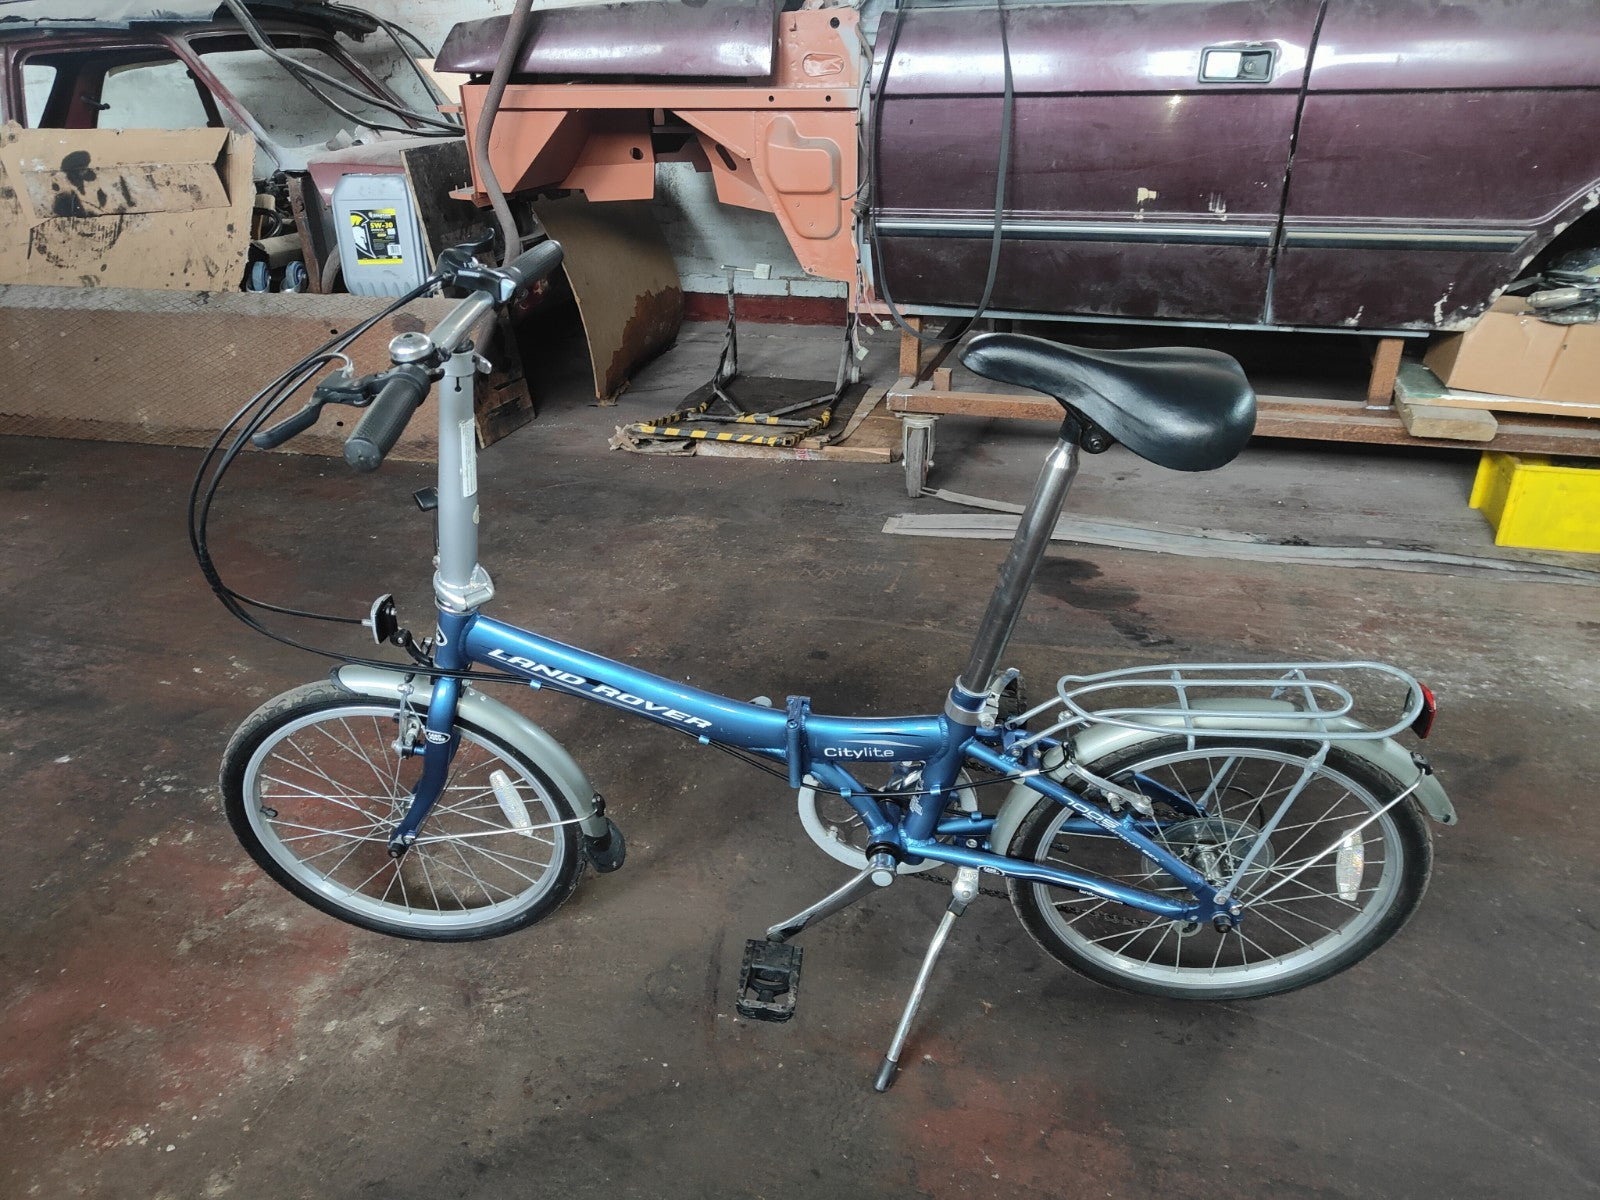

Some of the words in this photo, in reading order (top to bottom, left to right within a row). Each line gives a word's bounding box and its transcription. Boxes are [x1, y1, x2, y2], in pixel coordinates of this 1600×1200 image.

[370, 221, 393, 229] 5W-30
[488, 648, 587, 686] LAND
[591, 684, 713, 729] ROVER
[824, 747, 895, 759] Citylite
